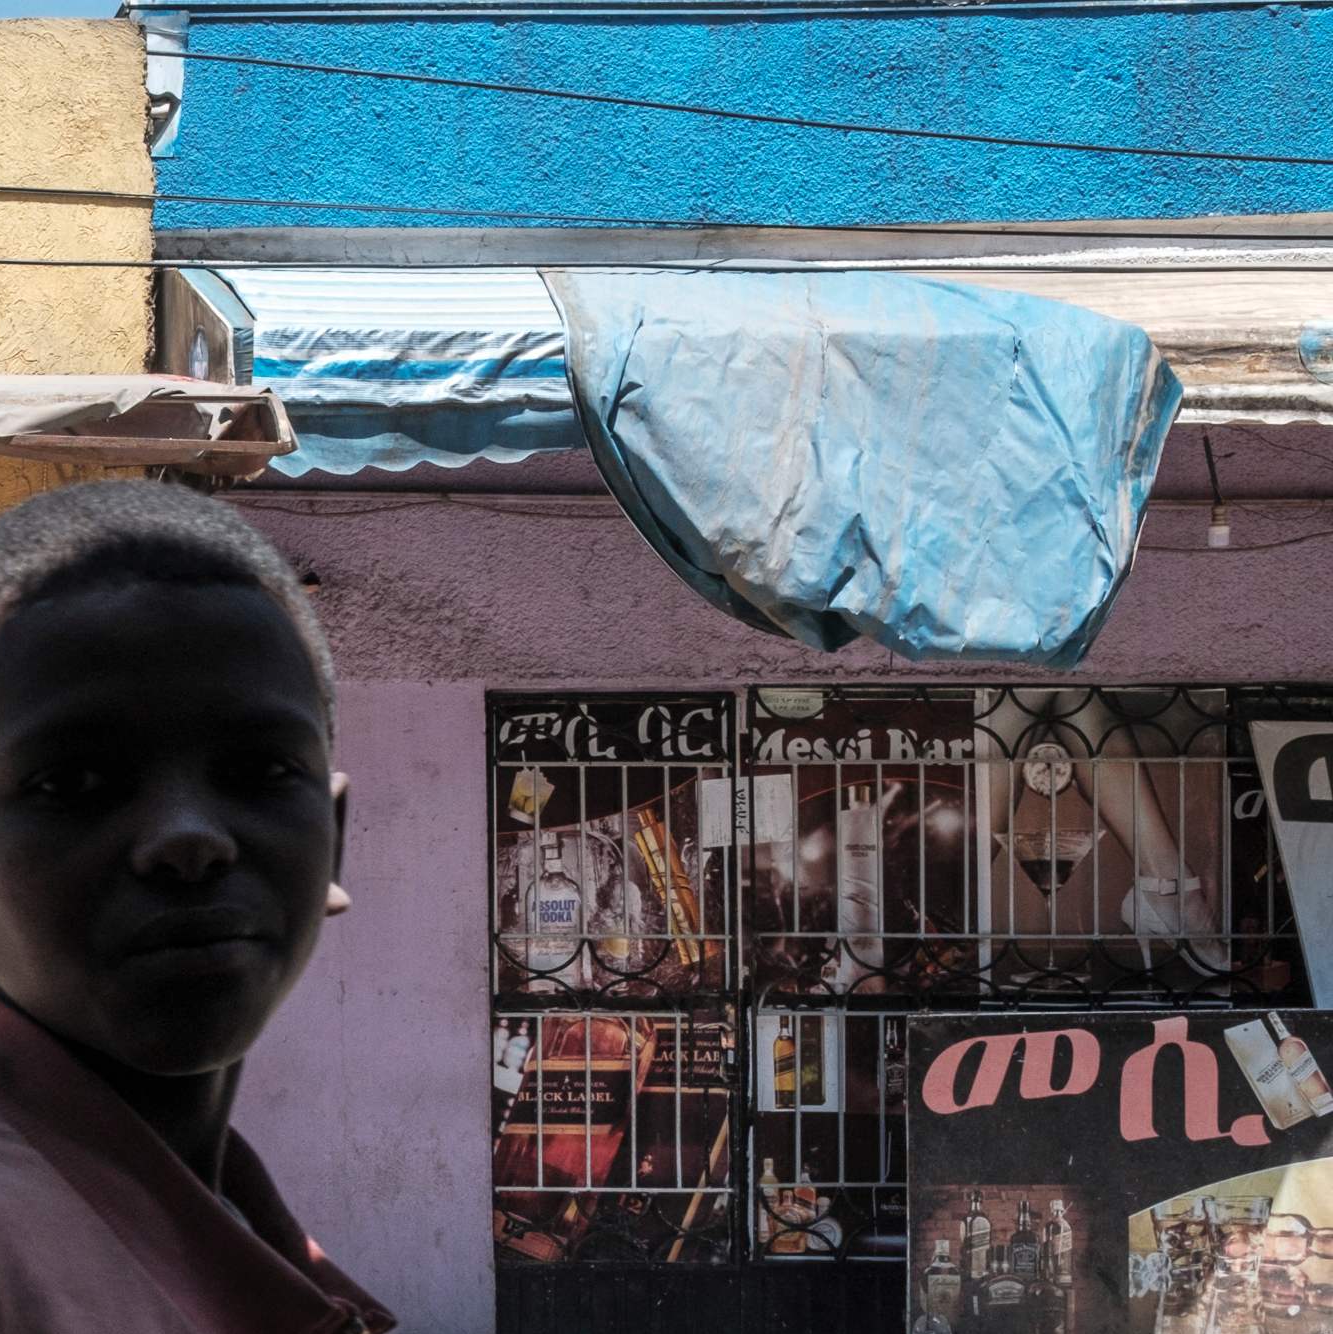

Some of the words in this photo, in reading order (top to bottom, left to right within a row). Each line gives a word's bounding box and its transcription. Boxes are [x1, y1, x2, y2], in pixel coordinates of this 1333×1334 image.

[746, 727, 873, 764] Messi
[886, 728, 974, 765] Bar
[538, 911, 573, 923] ODKA
[921, 1015, 1272, 1147] መሲ
